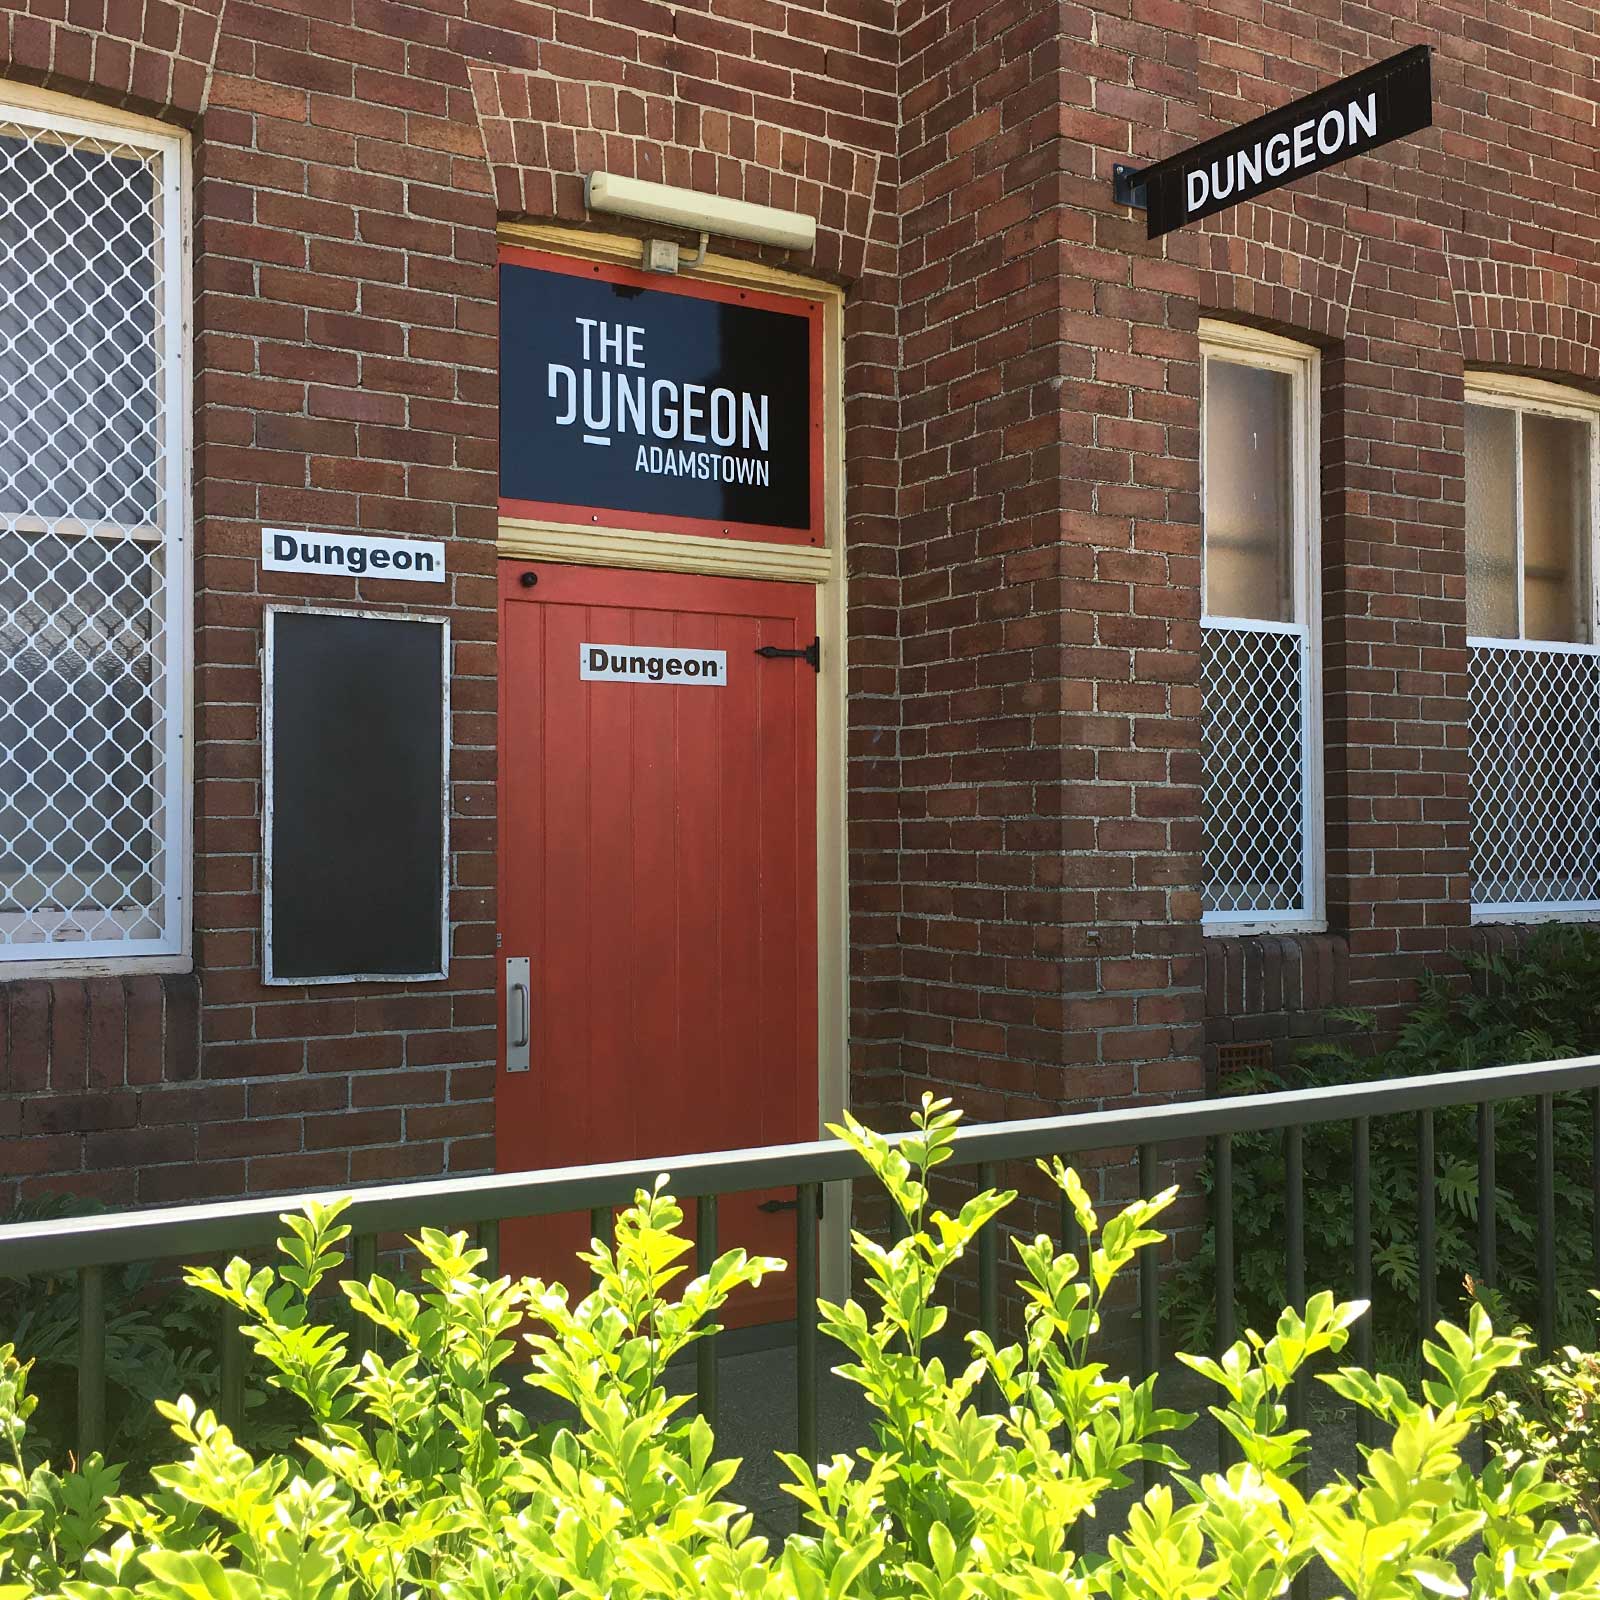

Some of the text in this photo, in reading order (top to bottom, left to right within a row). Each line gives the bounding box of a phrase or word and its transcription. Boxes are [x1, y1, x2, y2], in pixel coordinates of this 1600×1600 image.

[1187, 93, 1377, 212] DUNGEON
[576, 317, 645, 368] THE
[548, 363, 769, 451] DUNGEON
[635, 445, 769, 487] ADAMSTOWN
[273, 534, 434, 573] Dungeon
[589, 648, 718, 680] Dungeon
